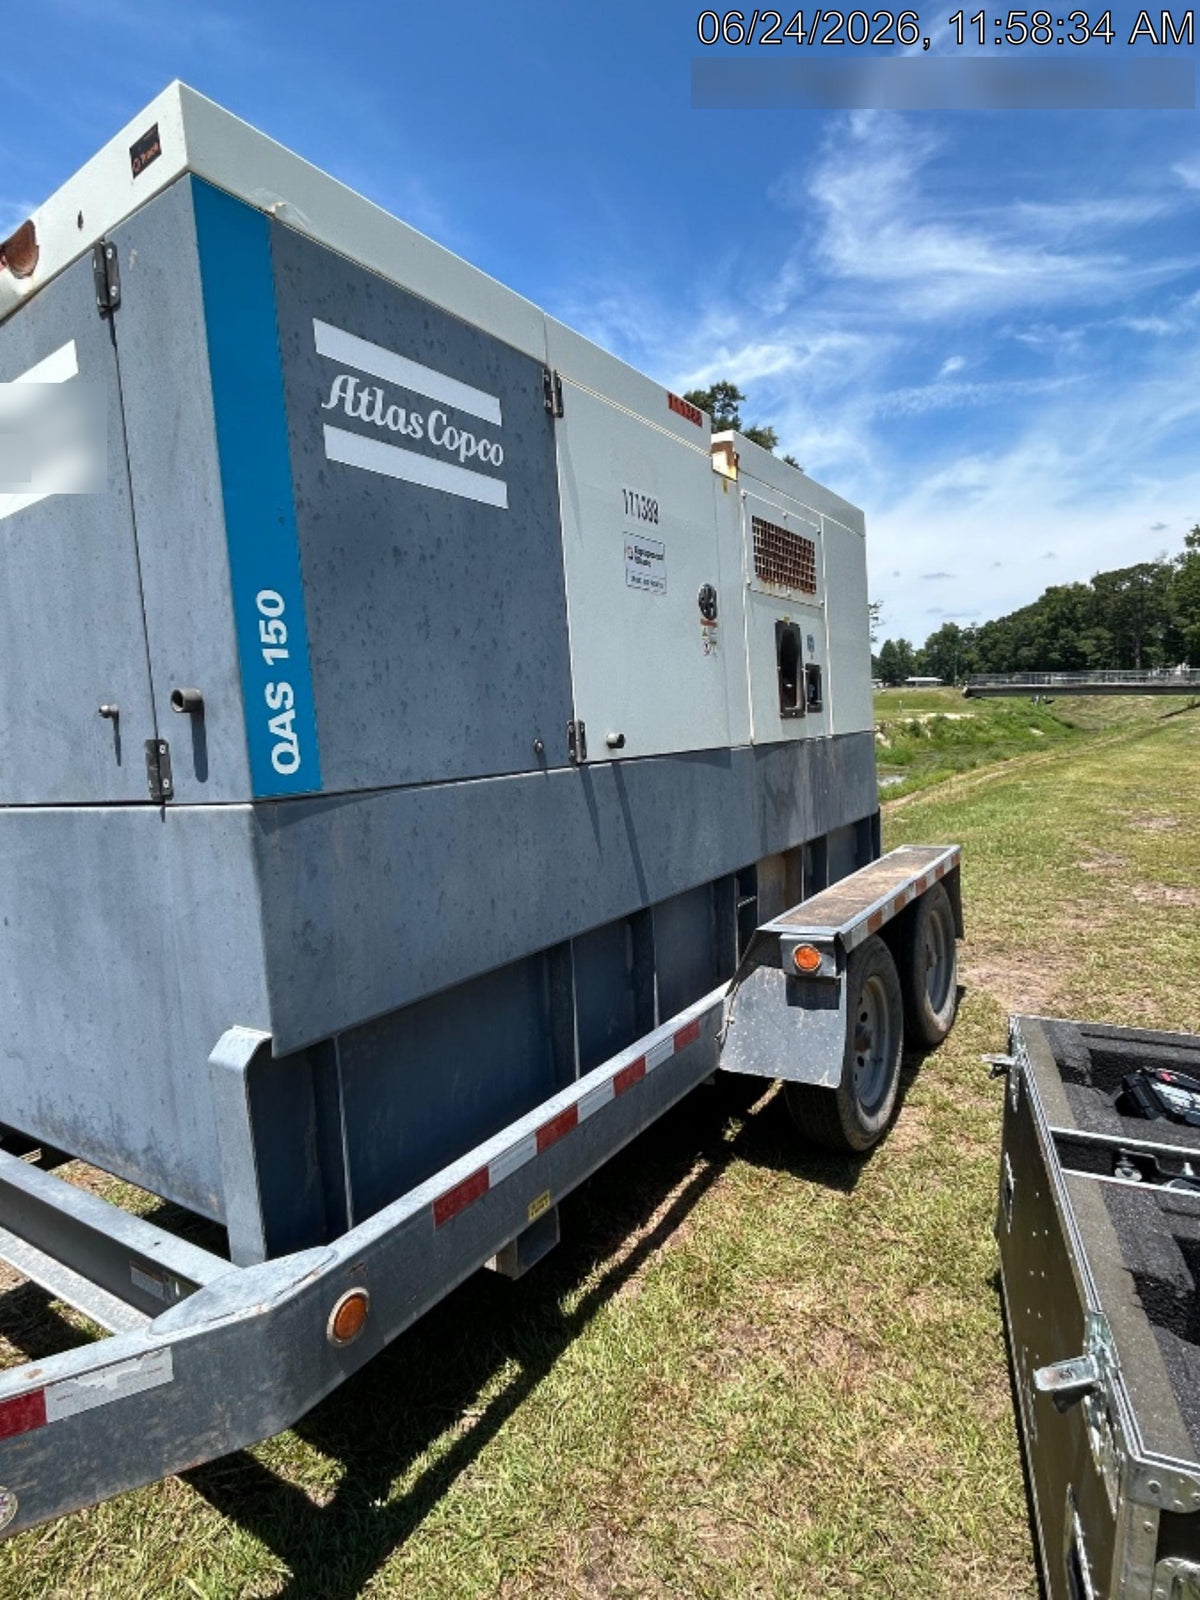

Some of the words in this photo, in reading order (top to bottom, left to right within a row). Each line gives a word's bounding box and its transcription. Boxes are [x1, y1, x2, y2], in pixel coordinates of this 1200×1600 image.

[321, 374, 424, 439] Atlas
[427, 410, 504, 467] Copco
[255, 589, 290, 666] 150
[264, 681, 301, 776] QAS
